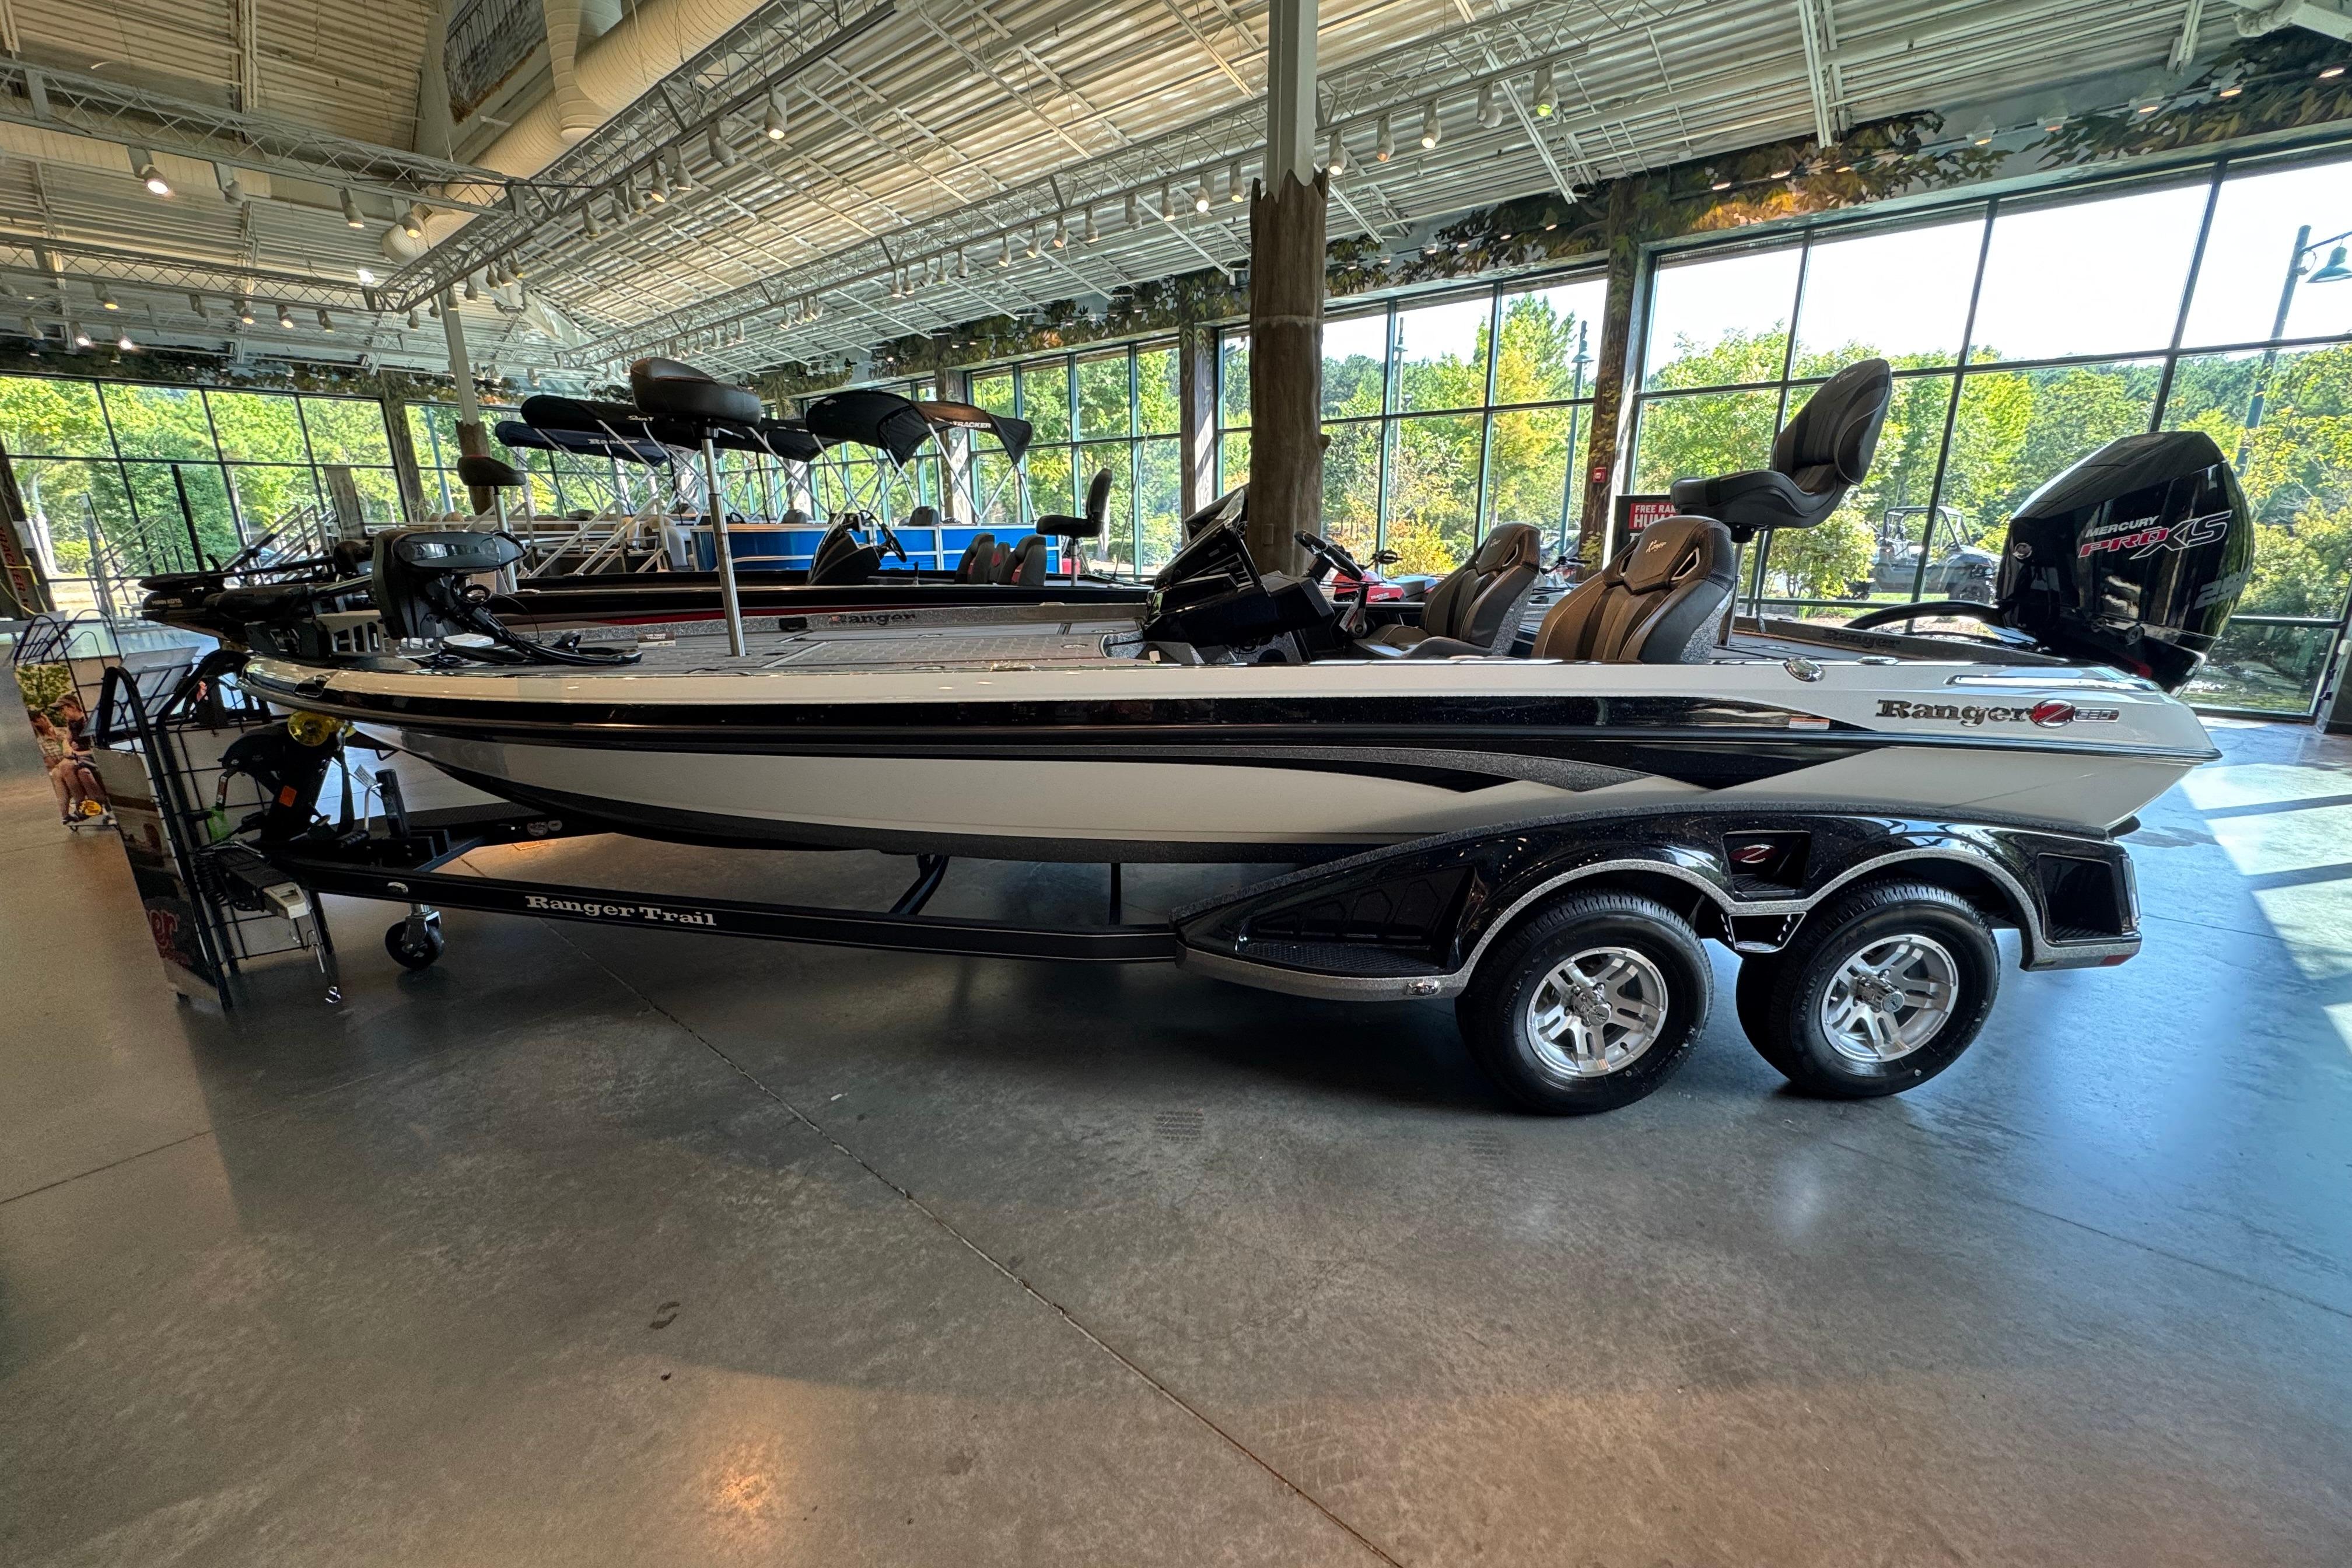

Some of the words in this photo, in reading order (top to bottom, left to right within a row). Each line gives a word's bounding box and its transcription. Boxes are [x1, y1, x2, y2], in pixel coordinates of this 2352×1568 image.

[1635, 505, 1657, 513] FREE
[1658, 504, 1676, 513] RAN
[2085, 515, 2160, 538] MERCURY
[2078, 526, 2169, 558] PRO
[828, 614, 916, 626] Ranger
[1875, 699, 2035, 727] Ranger
[525, 895, 635, 917] Ranger
[639, 906, 717, 926] Trail
